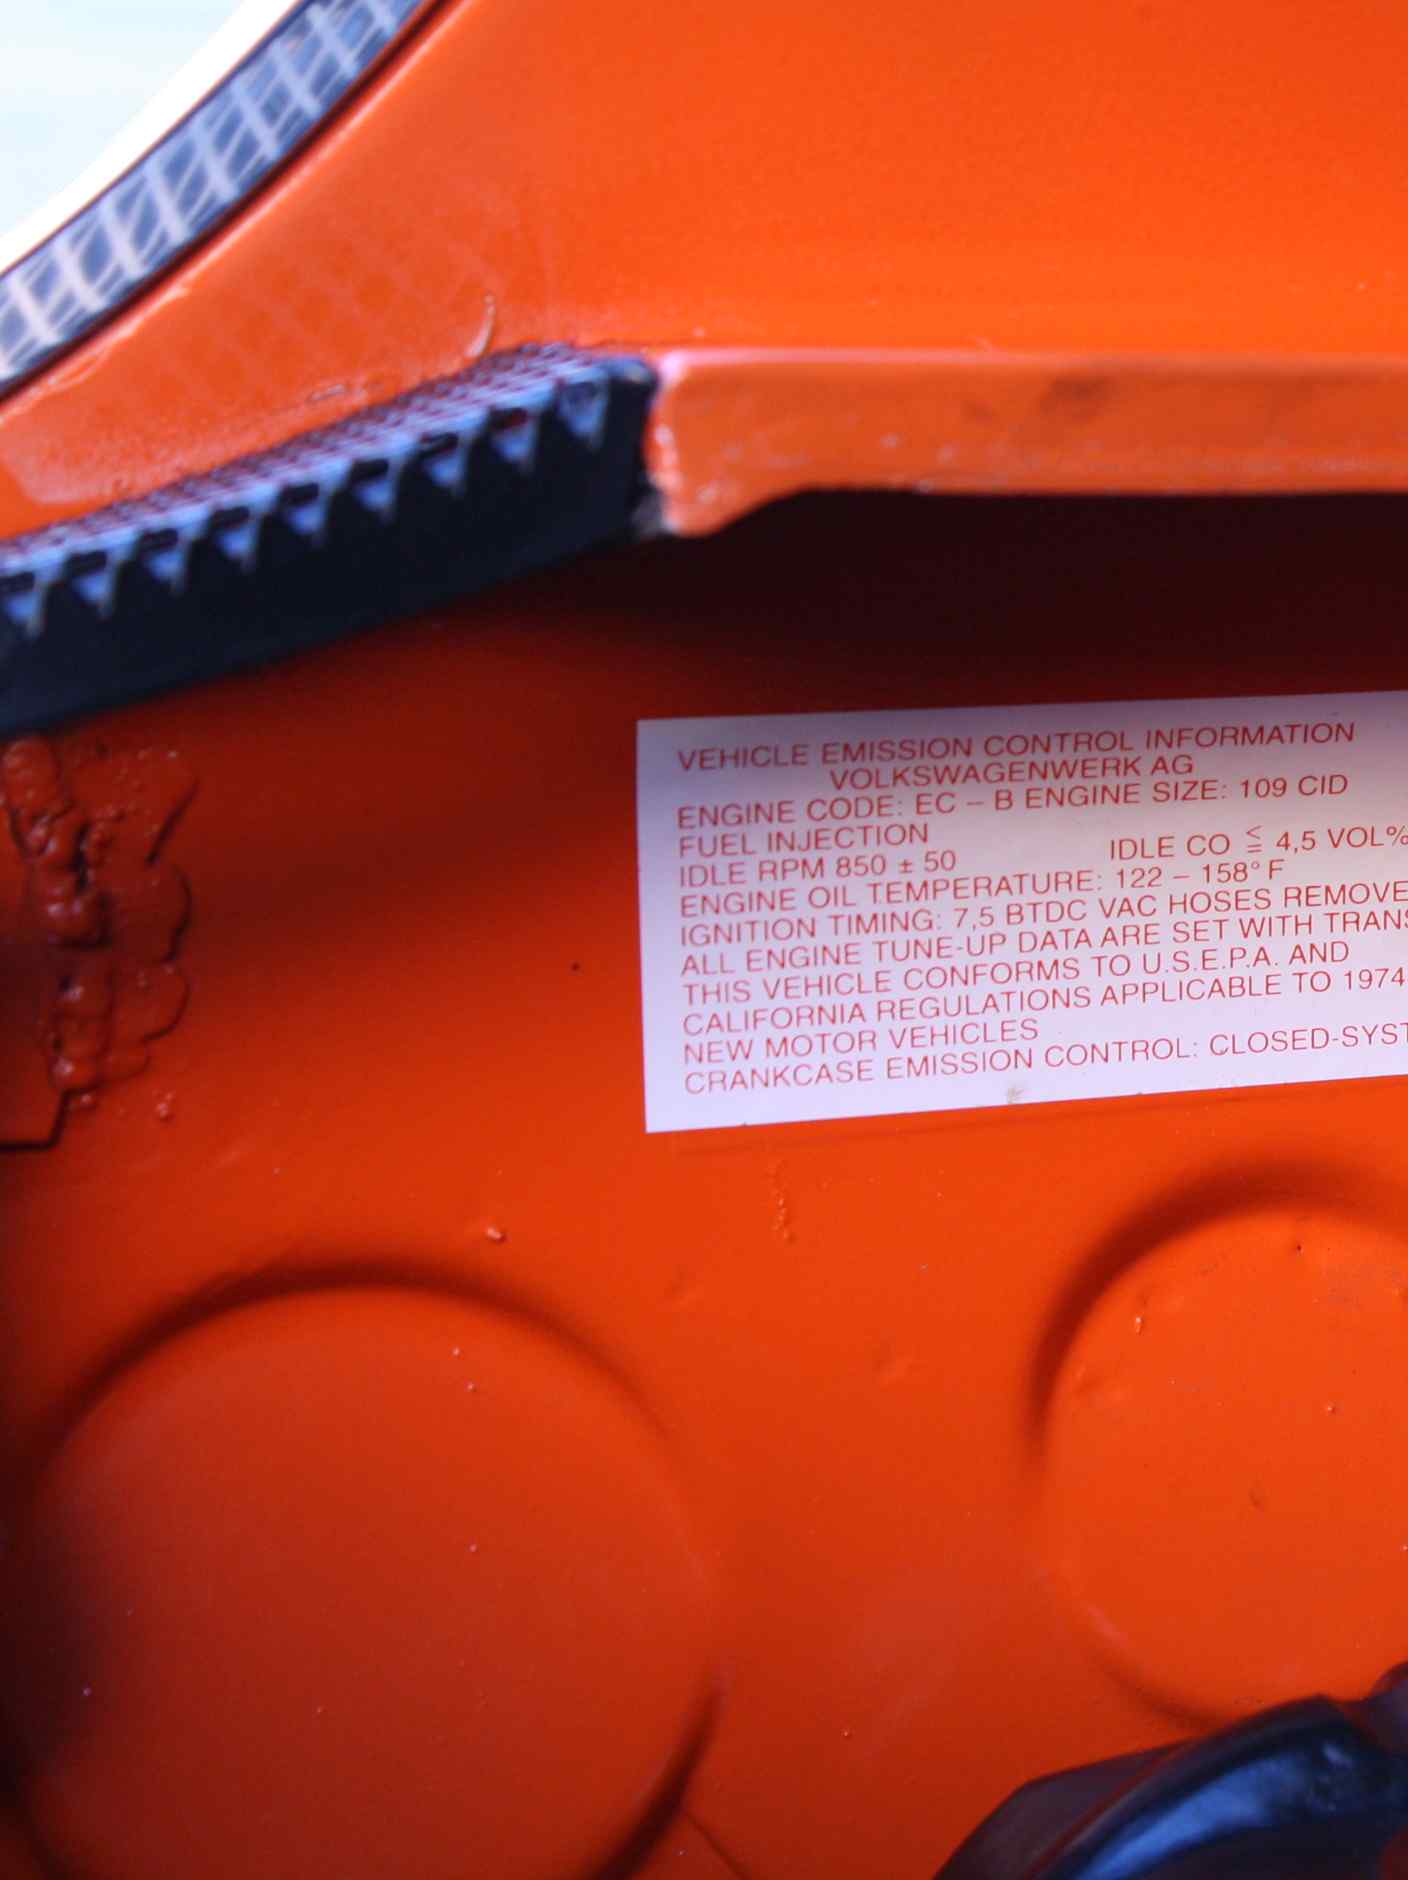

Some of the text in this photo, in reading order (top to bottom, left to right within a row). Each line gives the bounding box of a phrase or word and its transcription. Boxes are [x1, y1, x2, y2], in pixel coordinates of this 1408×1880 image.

[678, 722, 1354, 771] VEHICLE EMISSION CONTROL INFORMATION
[830, 754, 1194, 791] VOLKSWAGENWERK AG
[677, 800, 795, 829] ENGINE
[806, 795, 903, 822] CODE:
[916, 792, 955, 815] EC
[995, 789, 1013, 811] B
[1026, 783, 1141, 809] ENGINE
[1152, 779, 1226, 802] SIZE:
[1240, 777, 1287, 798] 109
[1298, 774, 1348, 796] CID
[680, 823, 928, 858] FUEL INJECTION
[1111, 836, 1174, 860] IDLE
[1187, 834, 1230, 856] CO
[1276, 831, 1316, 854] 4,5
[681, 862, 746, 887] IDLE
[759, 857, 824, 881] RPM
[836, 854, 886, 878] 850
[925, 850, 956, 872] 50
[681, 890, 795, 917] ENGINE
[808, 886, 856, 908] OIL
[867, 870, 1101, 904] TEMPERATURE:
[1117, 867, 1162, 888] 122
[682, 917, 816, 946] IGNITION
[829, 909, 940, 935] TIMING:
[954, 907, 994, 930] 7,5
[1006, 899, 1086, 925] BTDC
[1099, 895, 1156, 919] VAC
[1169, 888, 1271, 915] HOSES
[682, 954, 733, 975] ALL
[747, 943, 860, 972] ENGINE
[875, 933, 1006, 962] TUNE-UP
[1019, 928, 1092, 953] DATA
[1100, 923, 1160, 948] ARE
[1173, 919, 1229, 943] SET
[1238, 913, 1312, 939] WITH
[685, 941, 1349, 1005] THIS VEHICLE CONFORMS TO U.S.E.P.A. AND
[683, 1003, 866, 1035] CALIFORNIA
[877, 986, 1091, 1021] REGULATIONS
[1100, 974, 1281, 1007] APPLICABLE
[1295, 971, 1331, 992] TO
[1344, 967, 1405, 990] 1974
[685, 1018, 1038, 1063] NEW MOTOR VEHICLES
[686, 1060, 872, 1093] CRANKCASE
[887, 1048, 1032, 1079] EMISSION
[1045, 1038, 1198, 1067] CONTROL:
